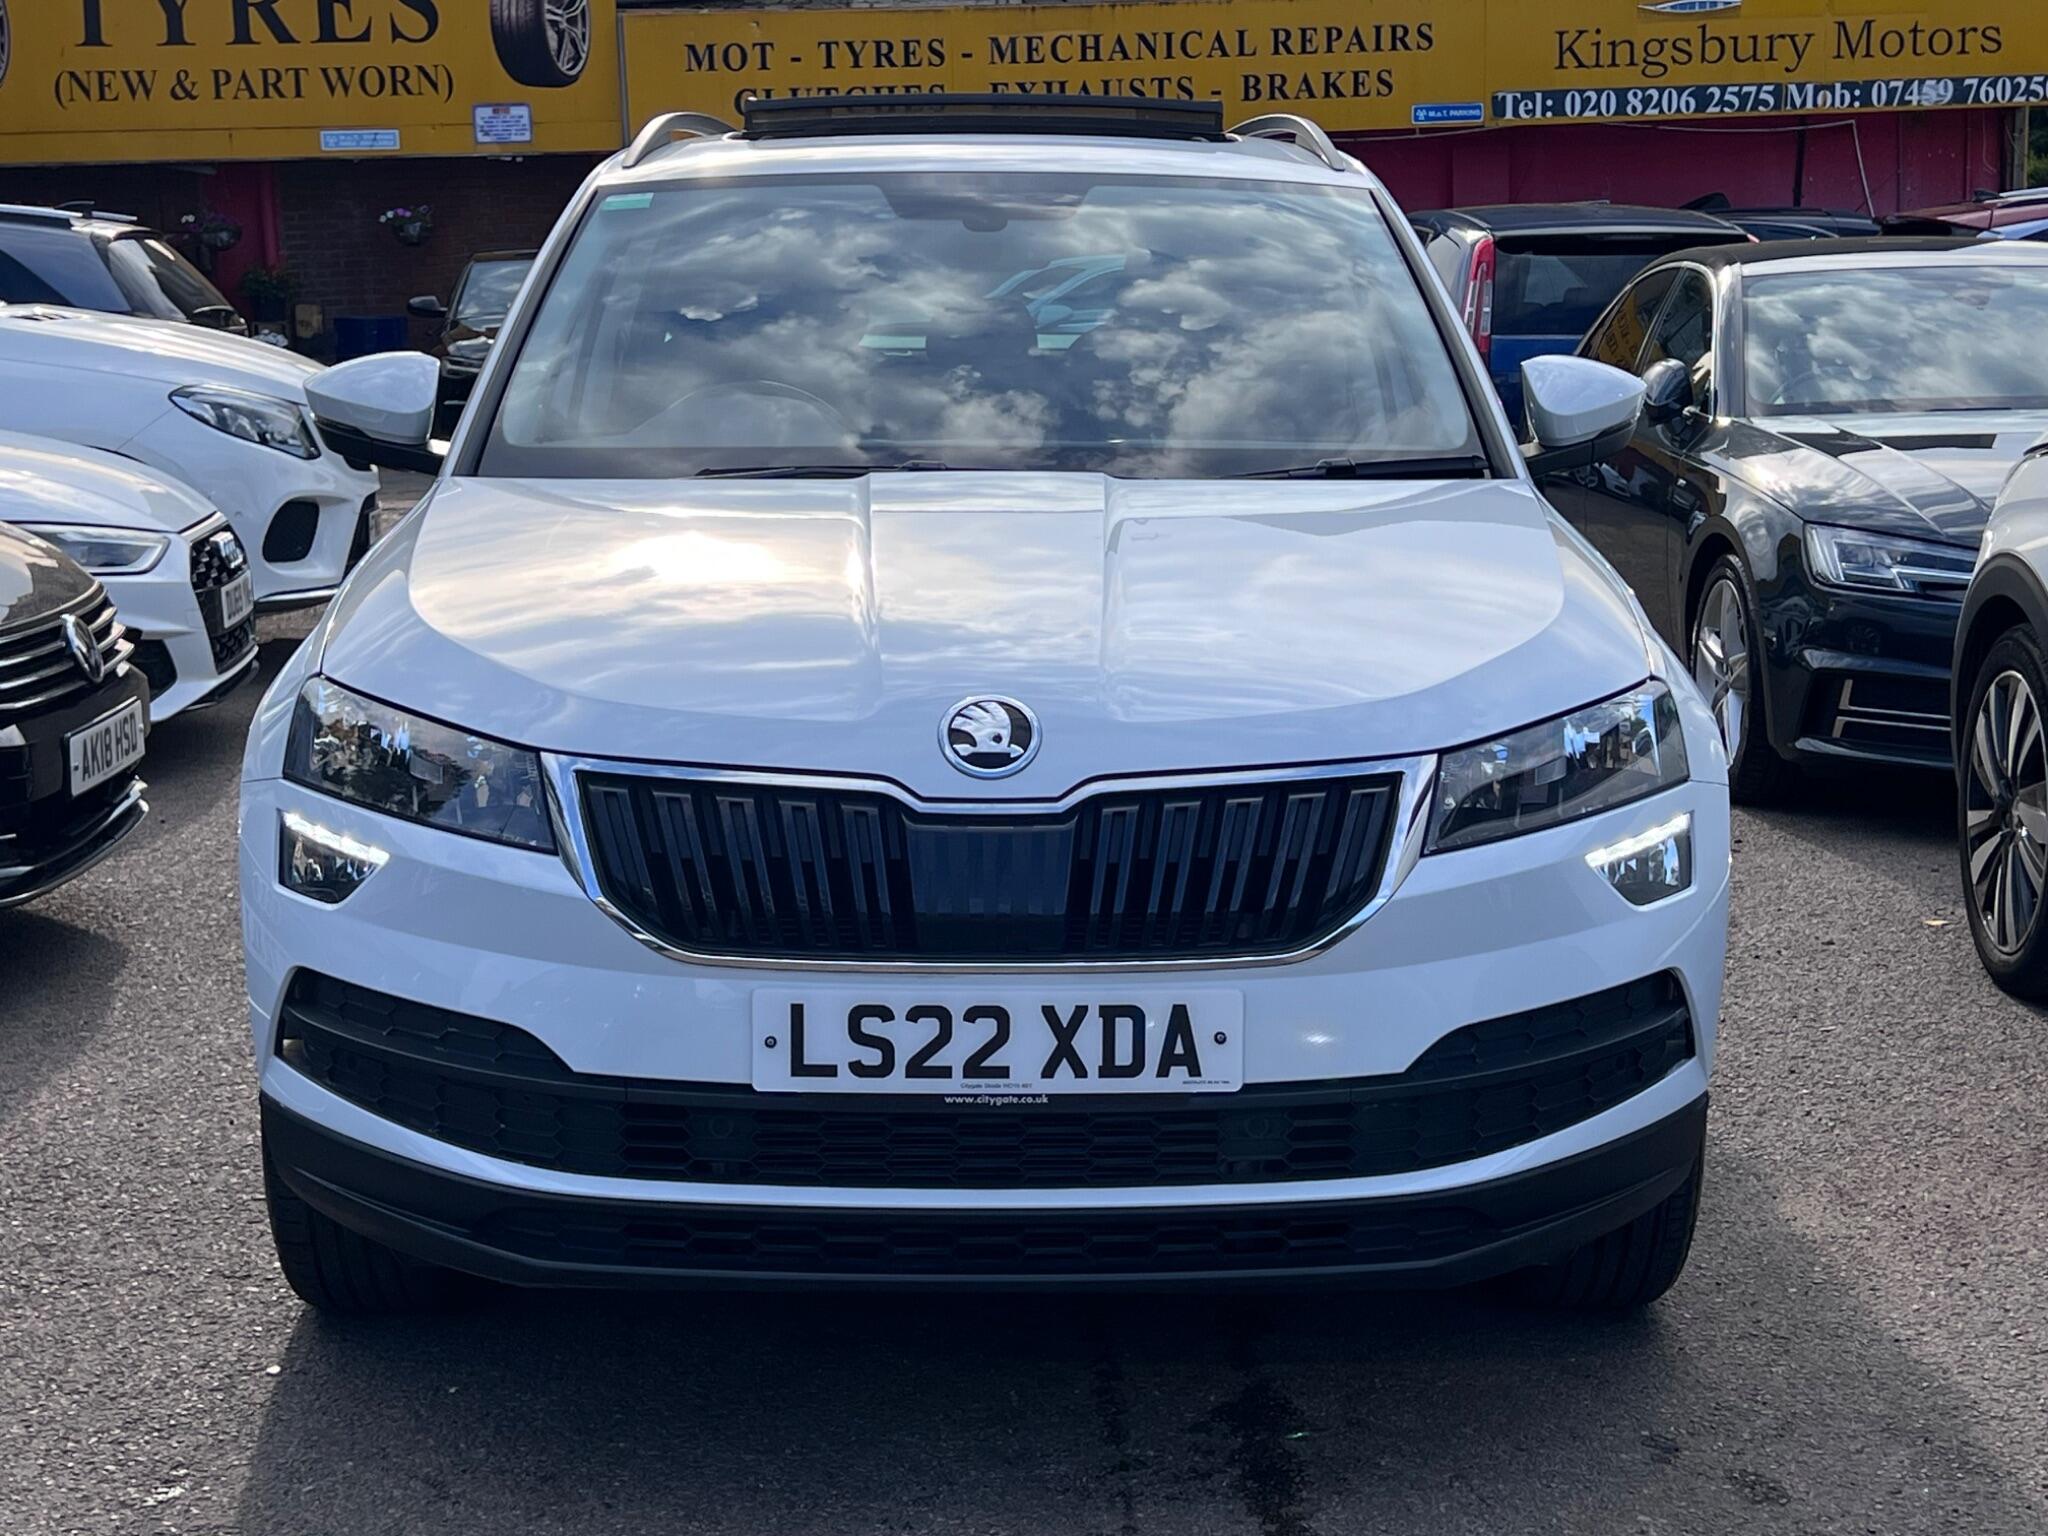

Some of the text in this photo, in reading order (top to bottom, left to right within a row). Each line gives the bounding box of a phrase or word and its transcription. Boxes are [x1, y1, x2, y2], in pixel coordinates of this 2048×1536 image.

[685, 42, 775, 72] MOT
[818, 38, 946, 70] TYRES
[988, 29, 1257, 65] MECHANICAL
[1270, 22, 1435, 56] REPAIRS
[1554, 18, 2004, 78] Kingsbury Motors
[54, 63, 455, 108] (NEW & PART WORN)
[1241, 69, 1394, 101] BRAKES
[1496, 75, 2048, 120] Tel: 020 8206 2575 Mob: 07459 76025
[82, 711, 138, 782] AK18 HSD
[790, 1003, 1202, 1080] LS22 XDA
[944, 1094, 1048, 1106] www.citygate.co.uk
